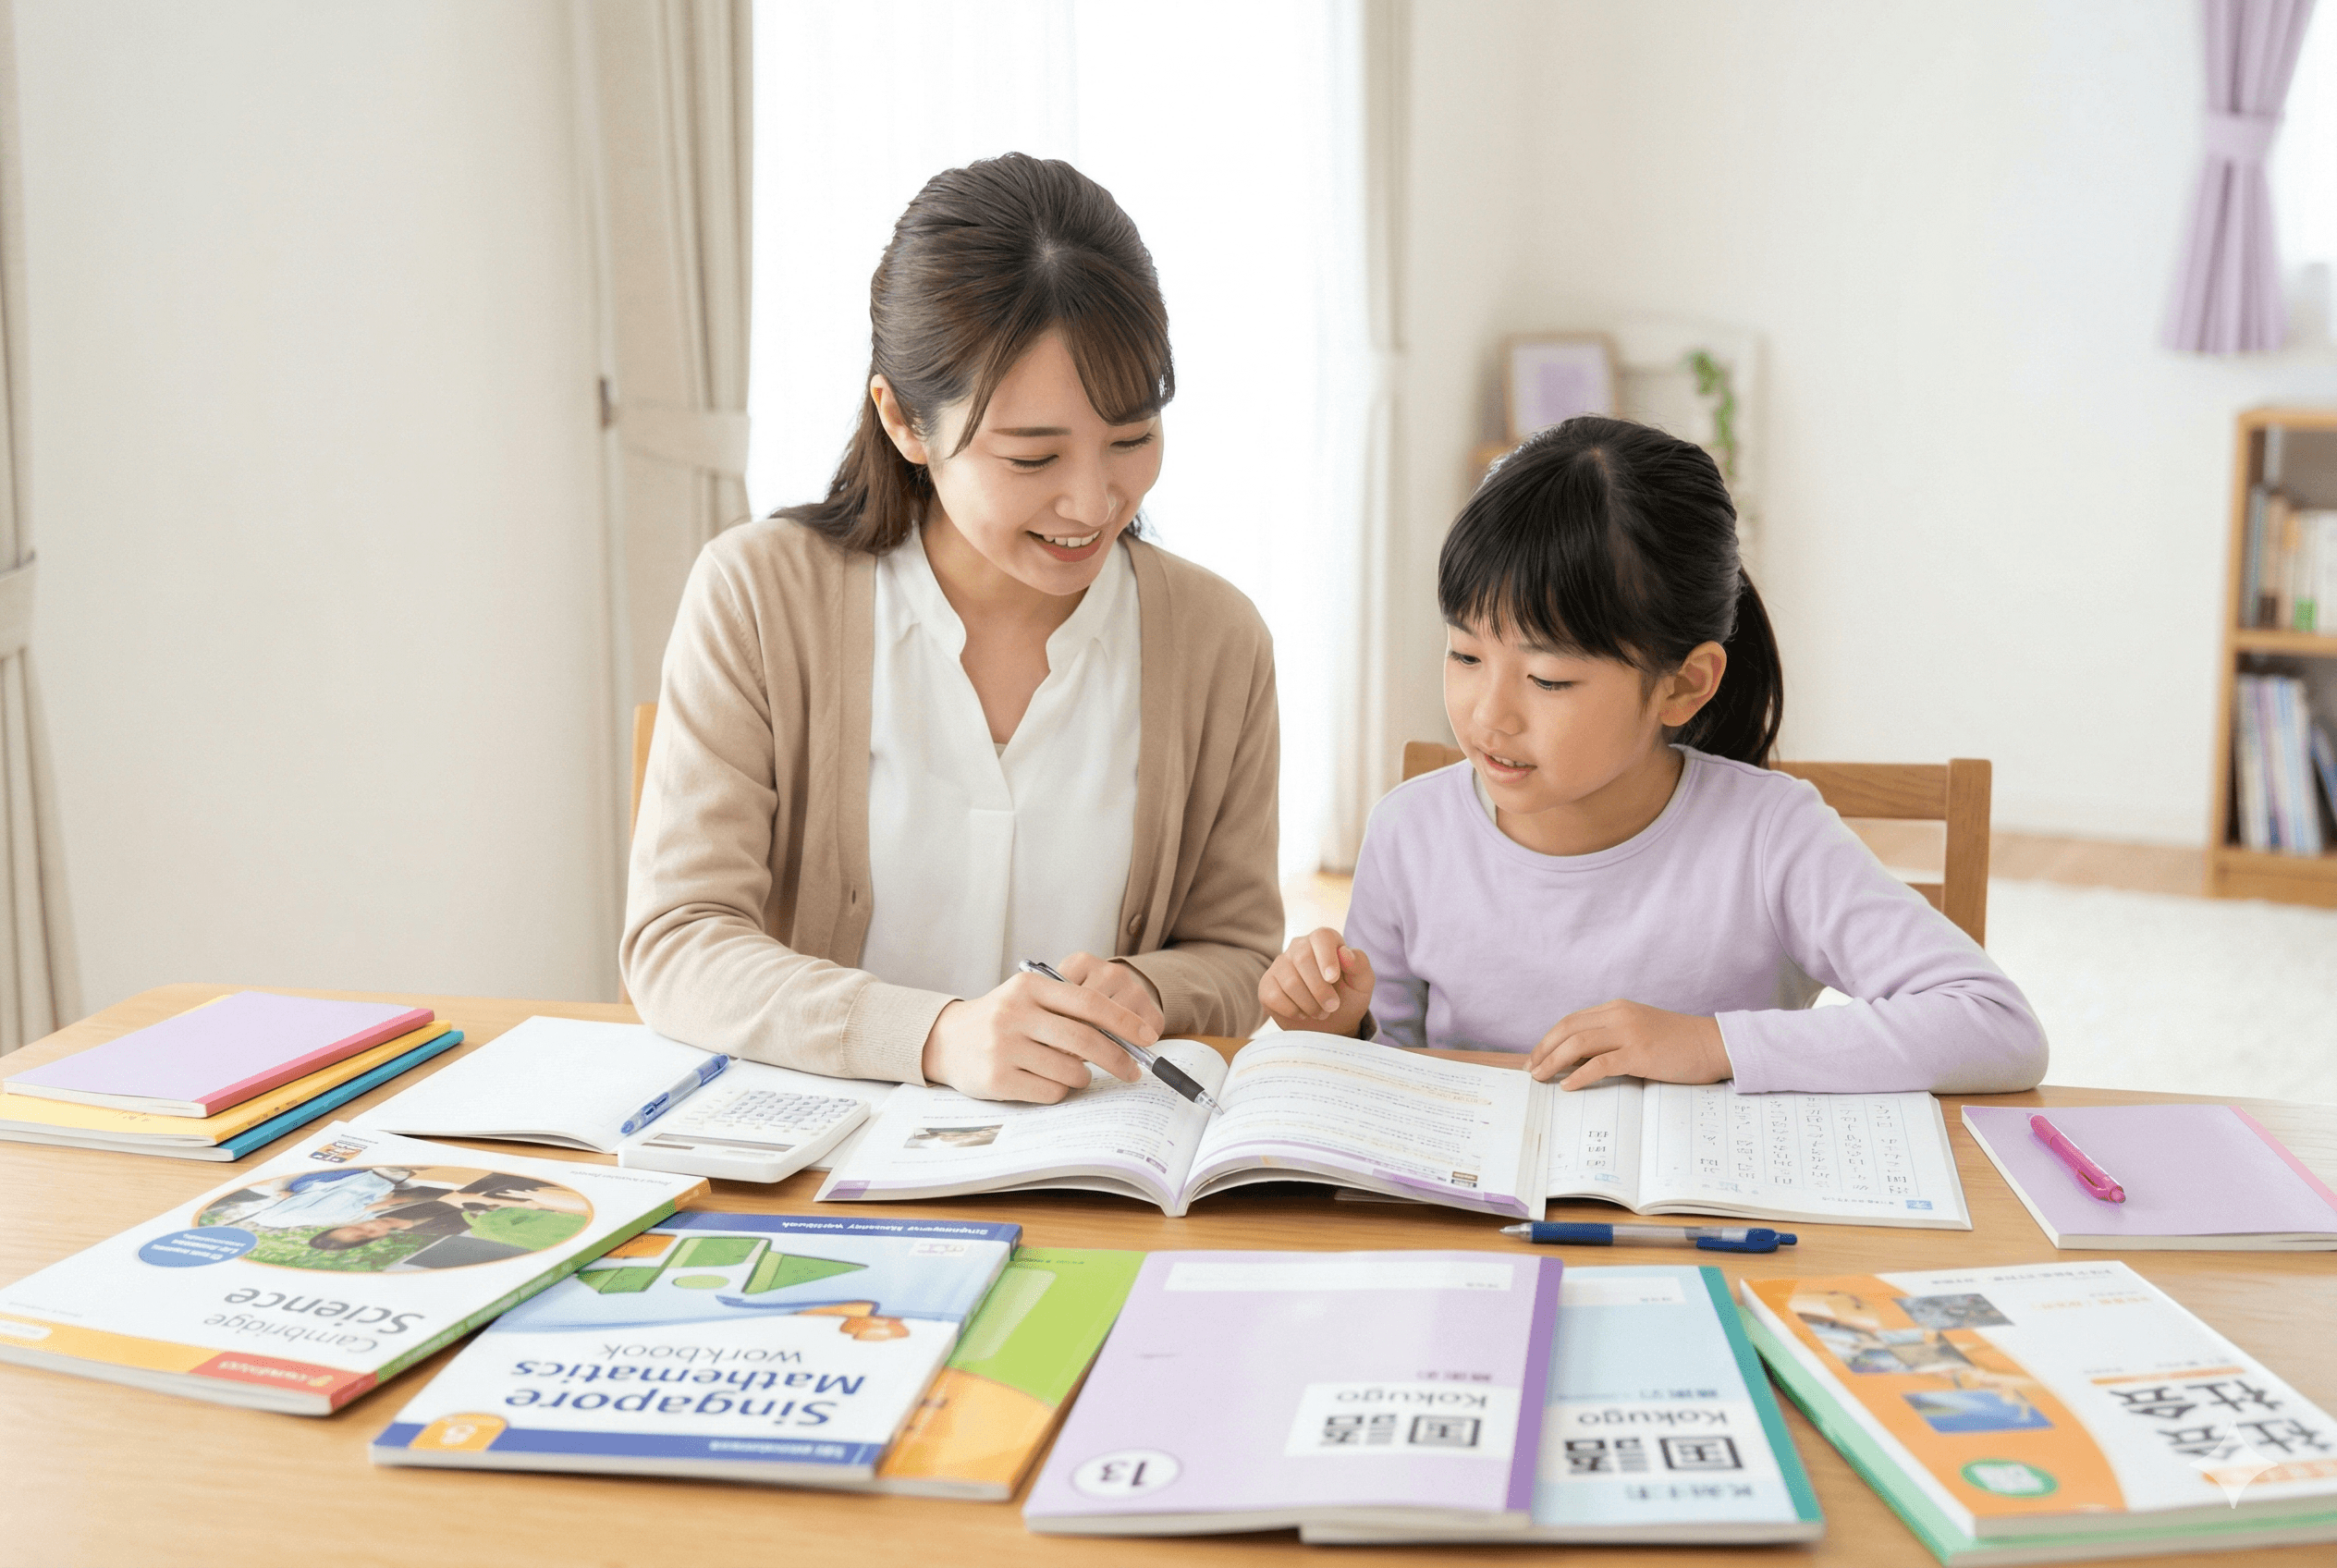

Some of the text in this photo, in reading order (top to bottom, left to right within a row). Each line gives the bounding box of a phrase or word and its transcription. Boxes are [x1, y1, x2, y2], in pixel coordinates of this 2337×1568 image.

[223, 1287, 426, 1335] Science
[202, 1313, 378, 1354] Cambridge
[510, 1360, 866, 1395] Mathematics
[504, 1387, 838, 1427] Singapore
[1336, 1389, 1487, 1409] Kokugo
[1577, 1409, 1729, 1427] Kokugo
[2109, 1378, 2283, 1419] 社会
[1319, 1414, 1482, 1448] 国語
[2156, 1418, 2332, 1461] 社会
[1564, 1436, 1744, 1476] 国語
